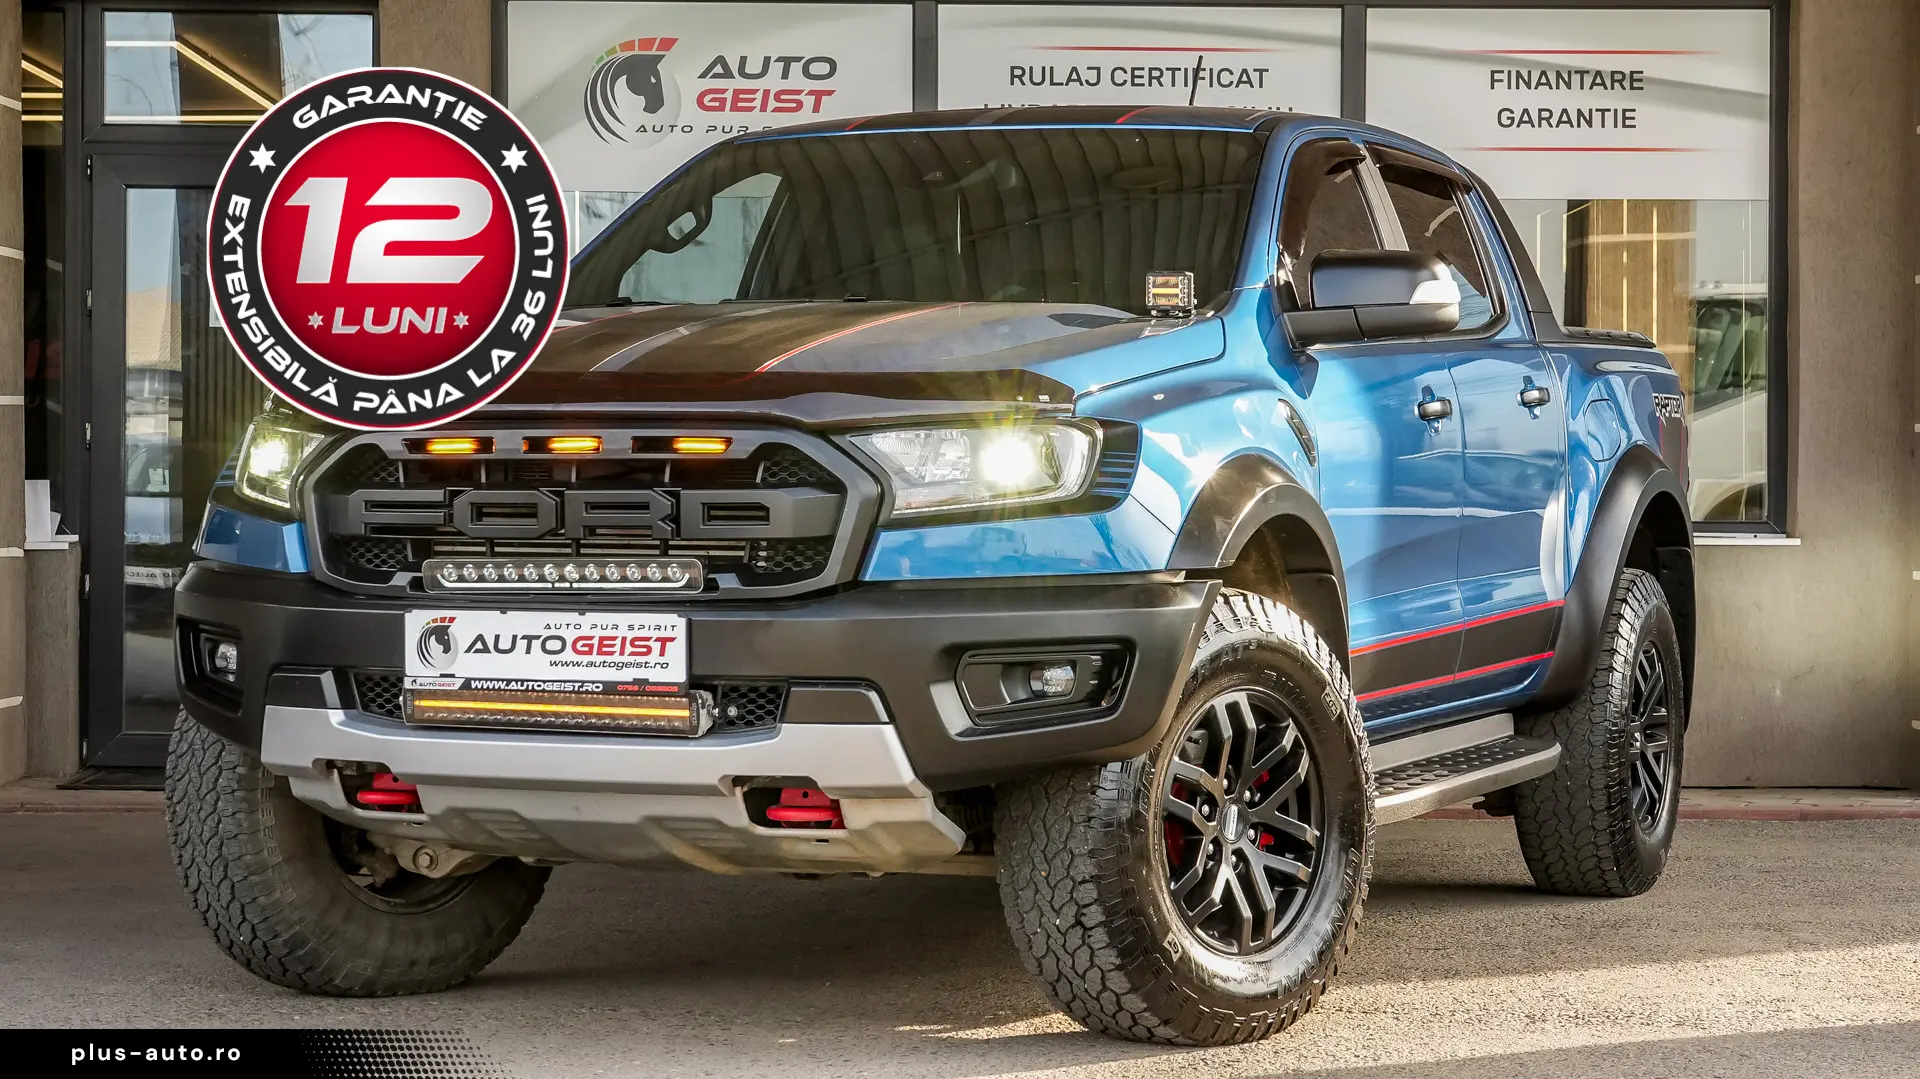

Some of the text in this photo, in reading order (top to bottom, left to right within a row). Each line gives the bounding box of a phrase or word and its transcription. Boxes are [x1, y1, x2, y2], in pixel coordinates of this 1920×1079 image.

[697, 54, 838, 81] AUTO
[1009, 66, 1101, 87] RULAJ
[1490, 69, 1645, 91] FINANTARE
[696, 88, 837, 113] GEIST
[1496, 107, 1637, 129] GARANTIE
[635, 124, 694, 134] AUTO
[705, 125, 749, 134] PUR
[590, 623, 619, 631] PUR
[627, 624, 678, 632] SPIRIT
[549, 658, 669, 670] www.autogeist.ro
[470, 680, 604, 692] WWW.AUTOGEIST.RO
